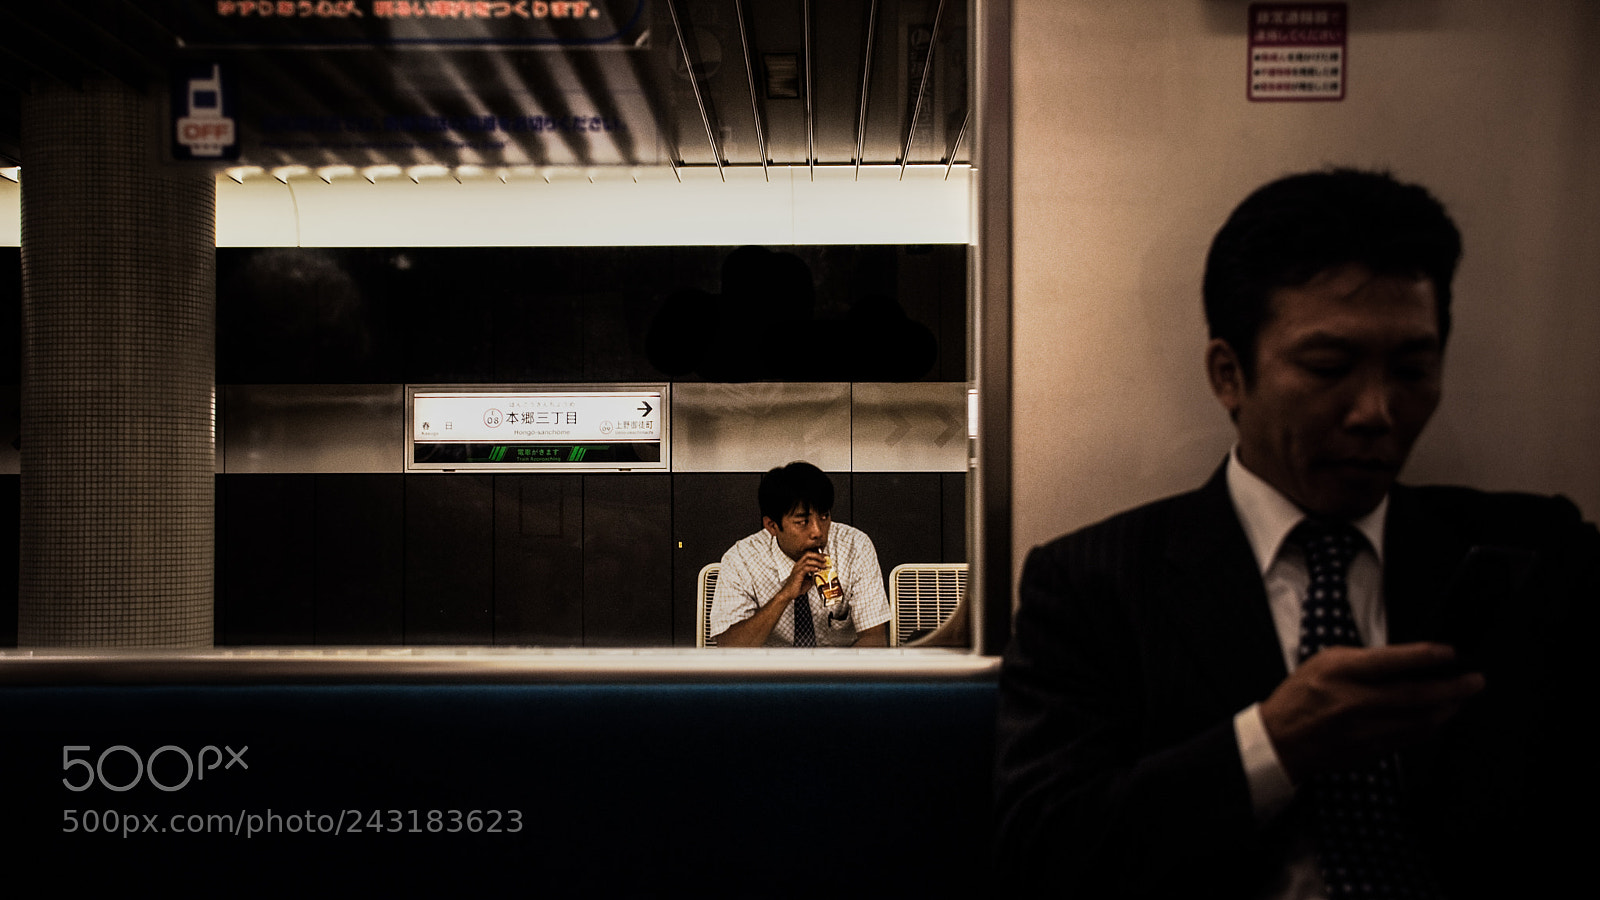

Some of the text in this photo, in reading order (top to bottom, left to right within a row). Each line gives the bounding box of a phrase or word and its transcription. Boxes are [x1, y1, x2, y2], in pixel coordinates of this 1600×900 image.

[183, 123, 230, 140] OFF
[505, 411, 578, 425] 本郷三丁目
